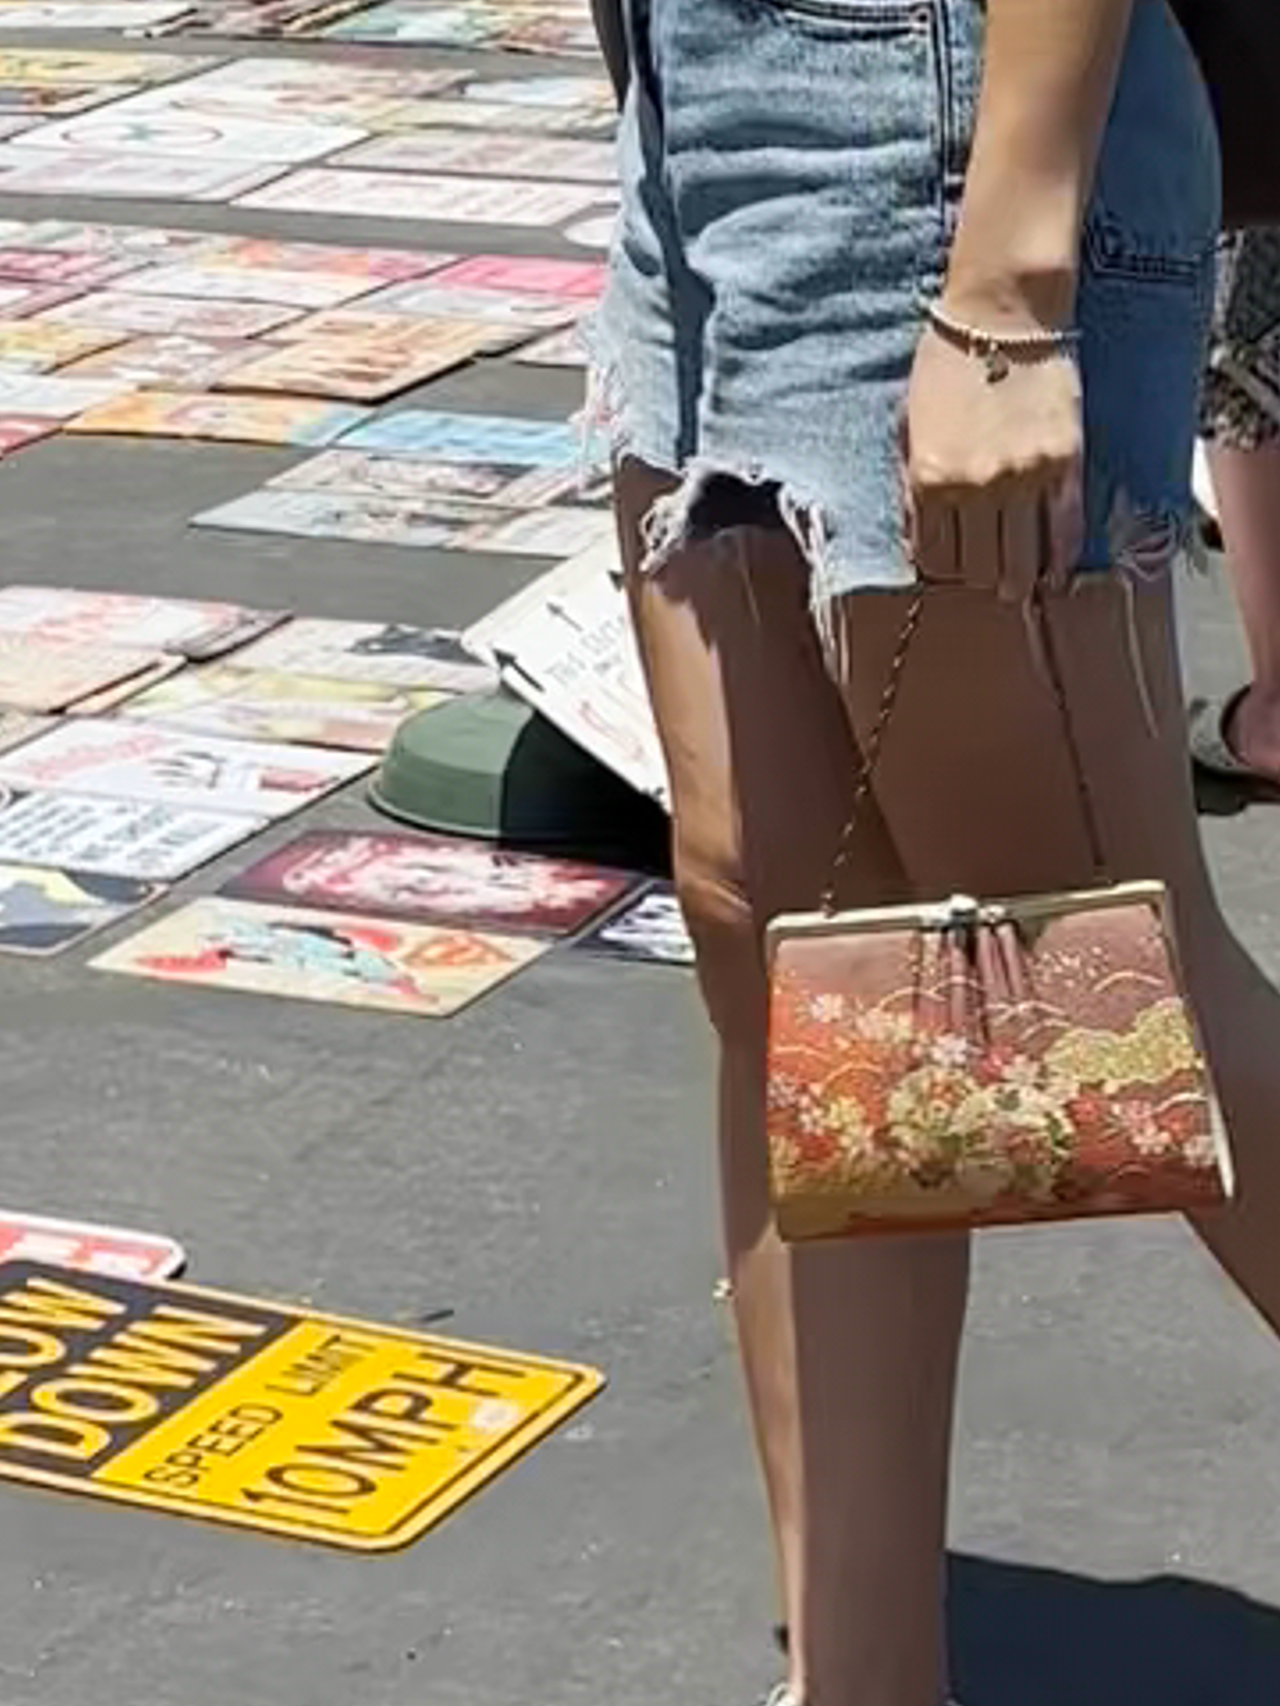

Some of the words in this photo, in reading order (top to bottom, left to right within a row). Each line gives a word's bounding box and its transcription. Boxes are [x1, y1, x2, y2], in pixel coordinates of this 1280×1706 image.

[144, 1402, 283, 1489] SPEED
[283, 1333, 381, 1398] LIMIT
[240, 1351, 526, 1515] 10MPH
